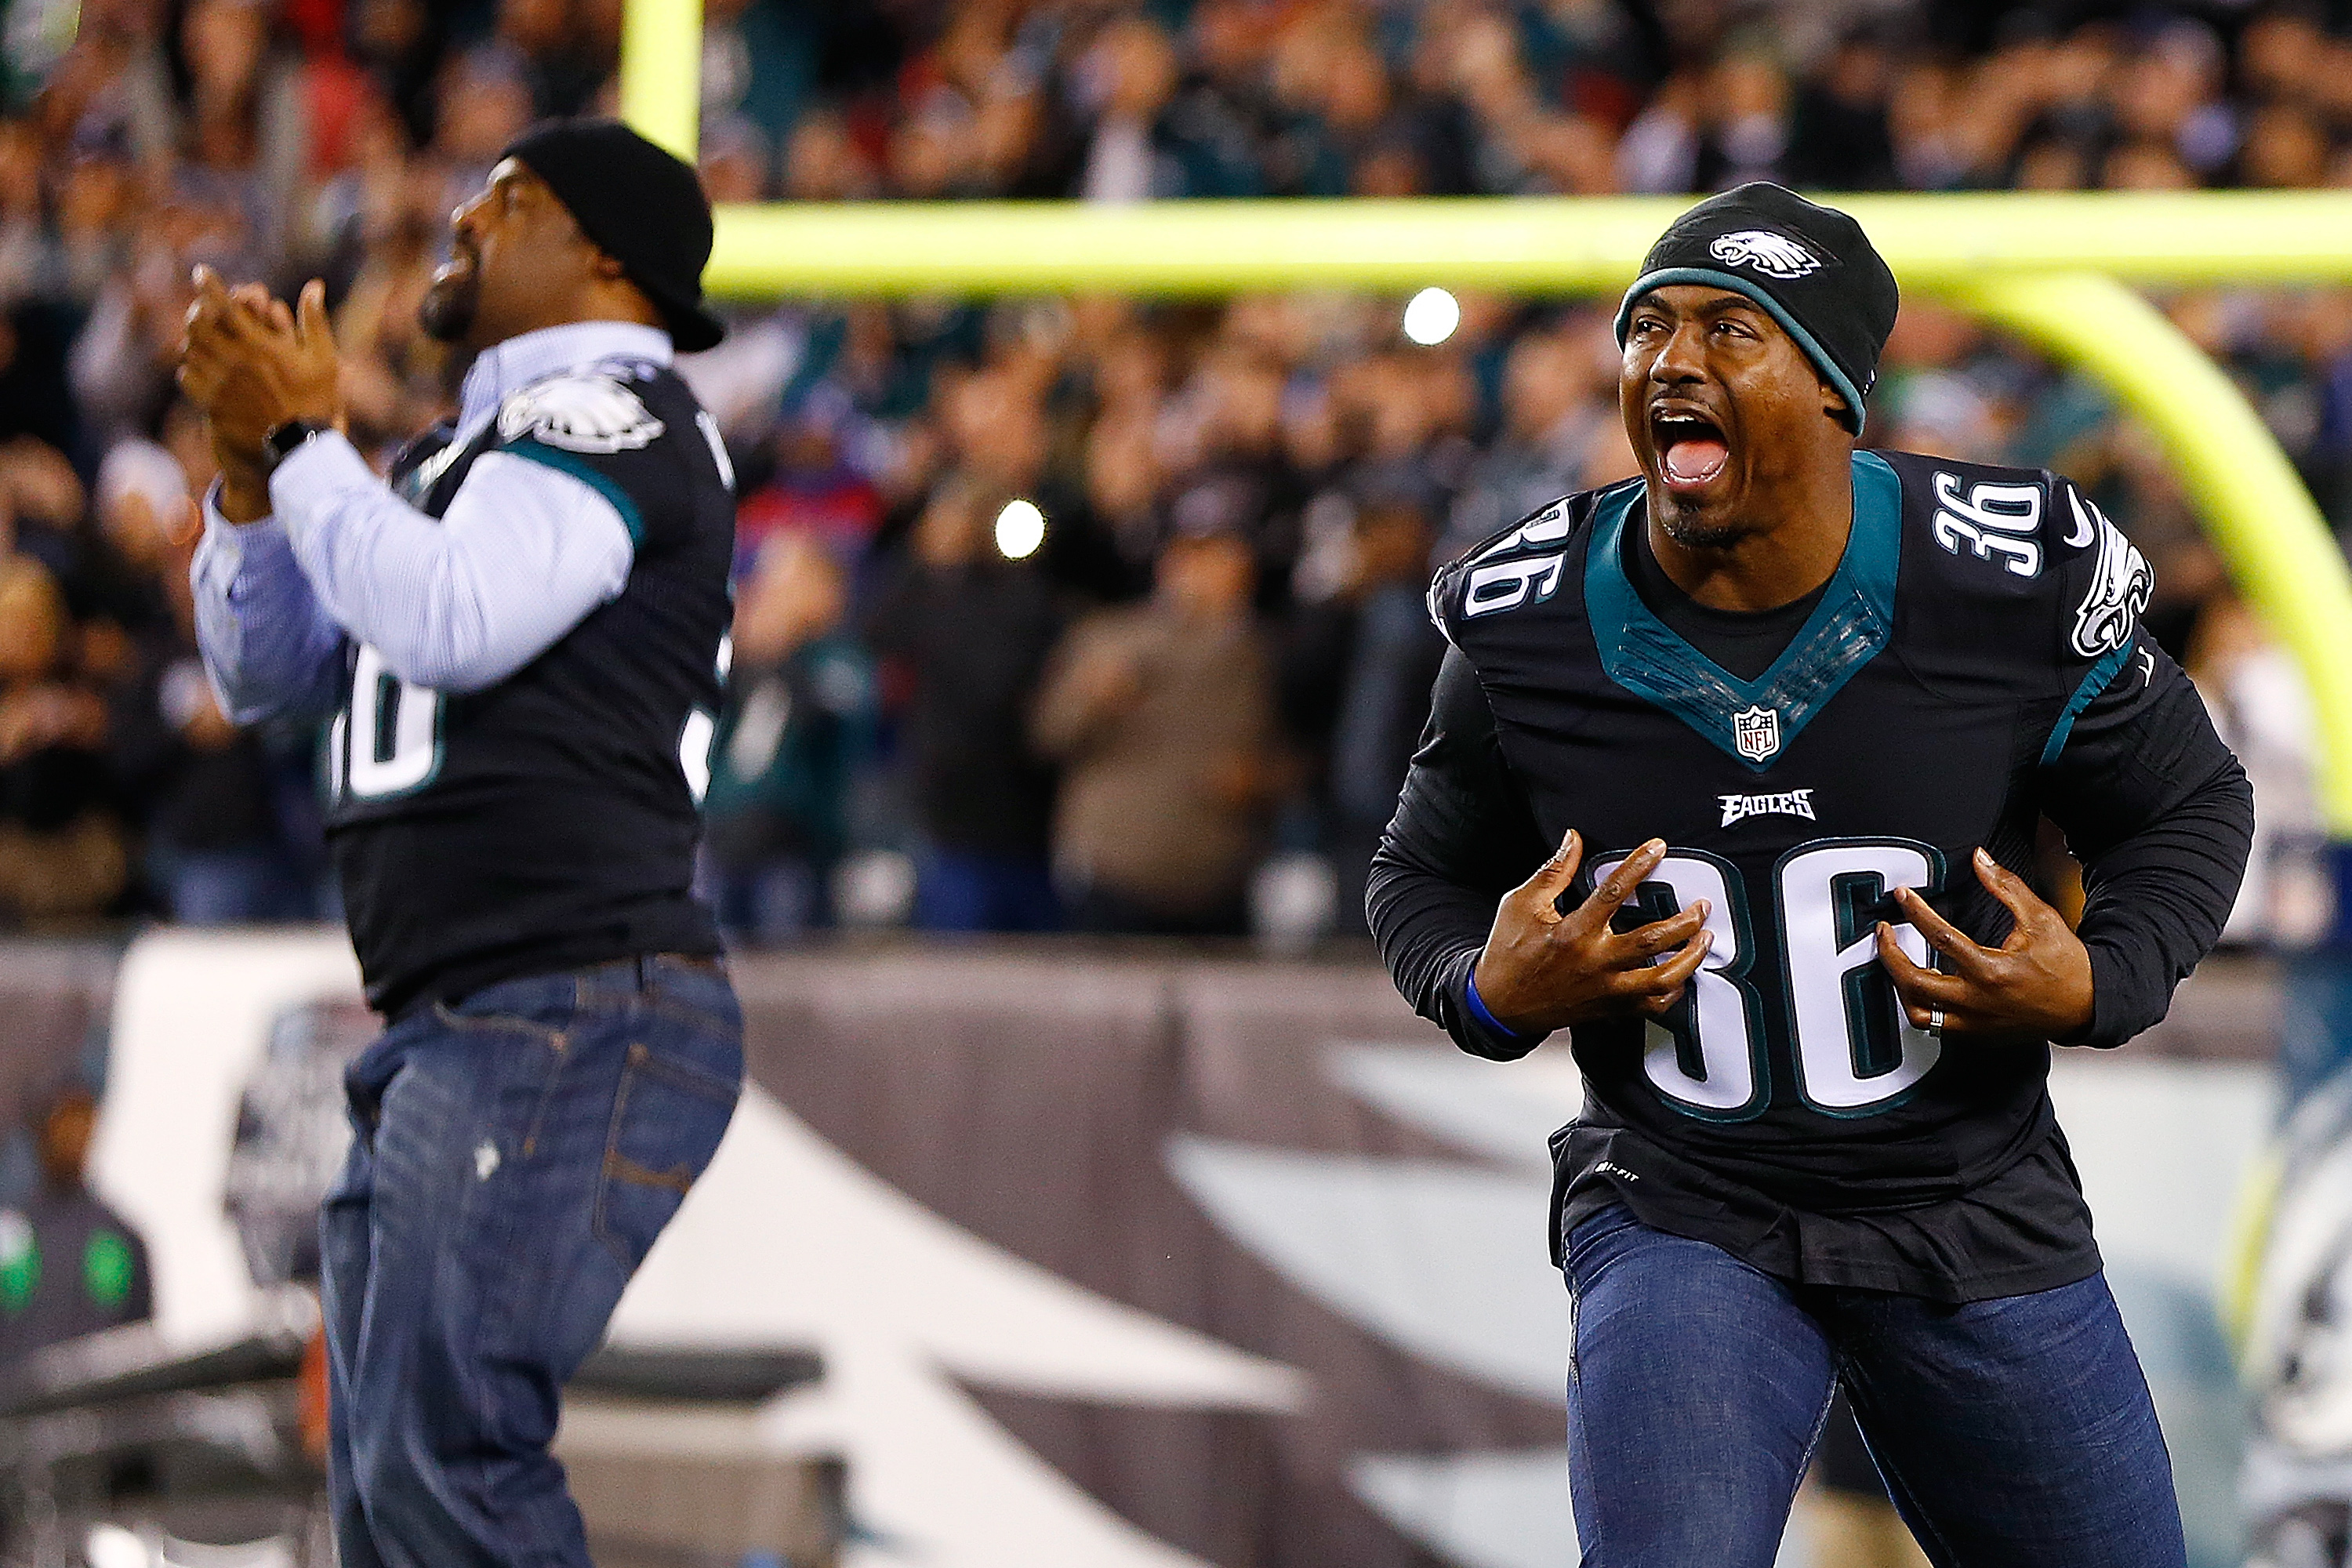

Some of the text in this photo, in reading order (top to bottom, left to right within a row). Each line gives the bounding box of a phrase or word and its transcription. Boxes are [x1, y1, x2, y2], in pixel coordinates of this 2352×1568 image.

[1932, 470, 2045, 579] 36
[1743, 731, 1772, 751] NFL
[1717, 789, 1817, 828] EAGLES
[1587, 838, 1946, 1122] 36
[1595, 1161, 1639, 1181] I-FIT
